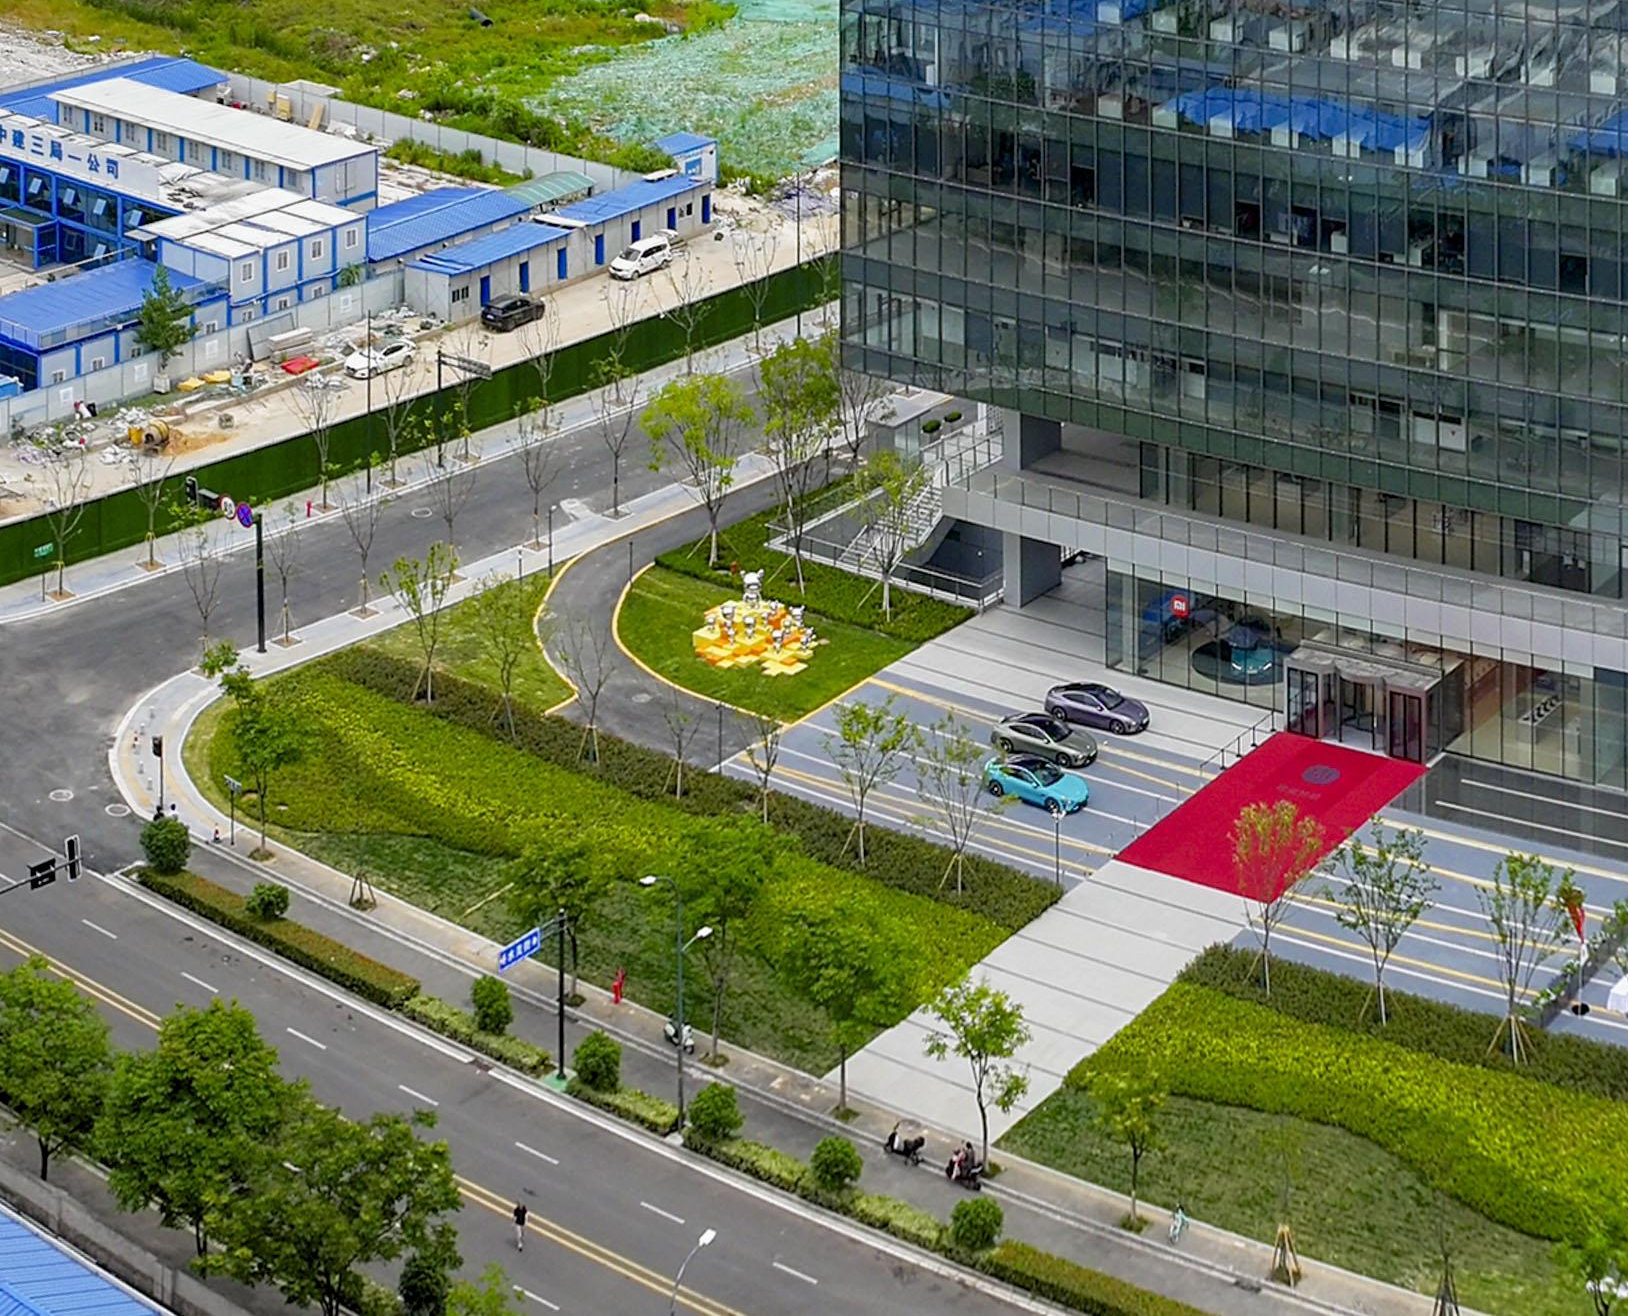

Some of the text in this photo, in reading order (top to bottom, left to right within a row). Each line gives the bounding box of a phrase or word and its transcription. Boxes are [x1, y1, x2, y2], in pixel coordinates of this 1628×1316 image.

[0, 123, 119, 180] 中建三局一公司
